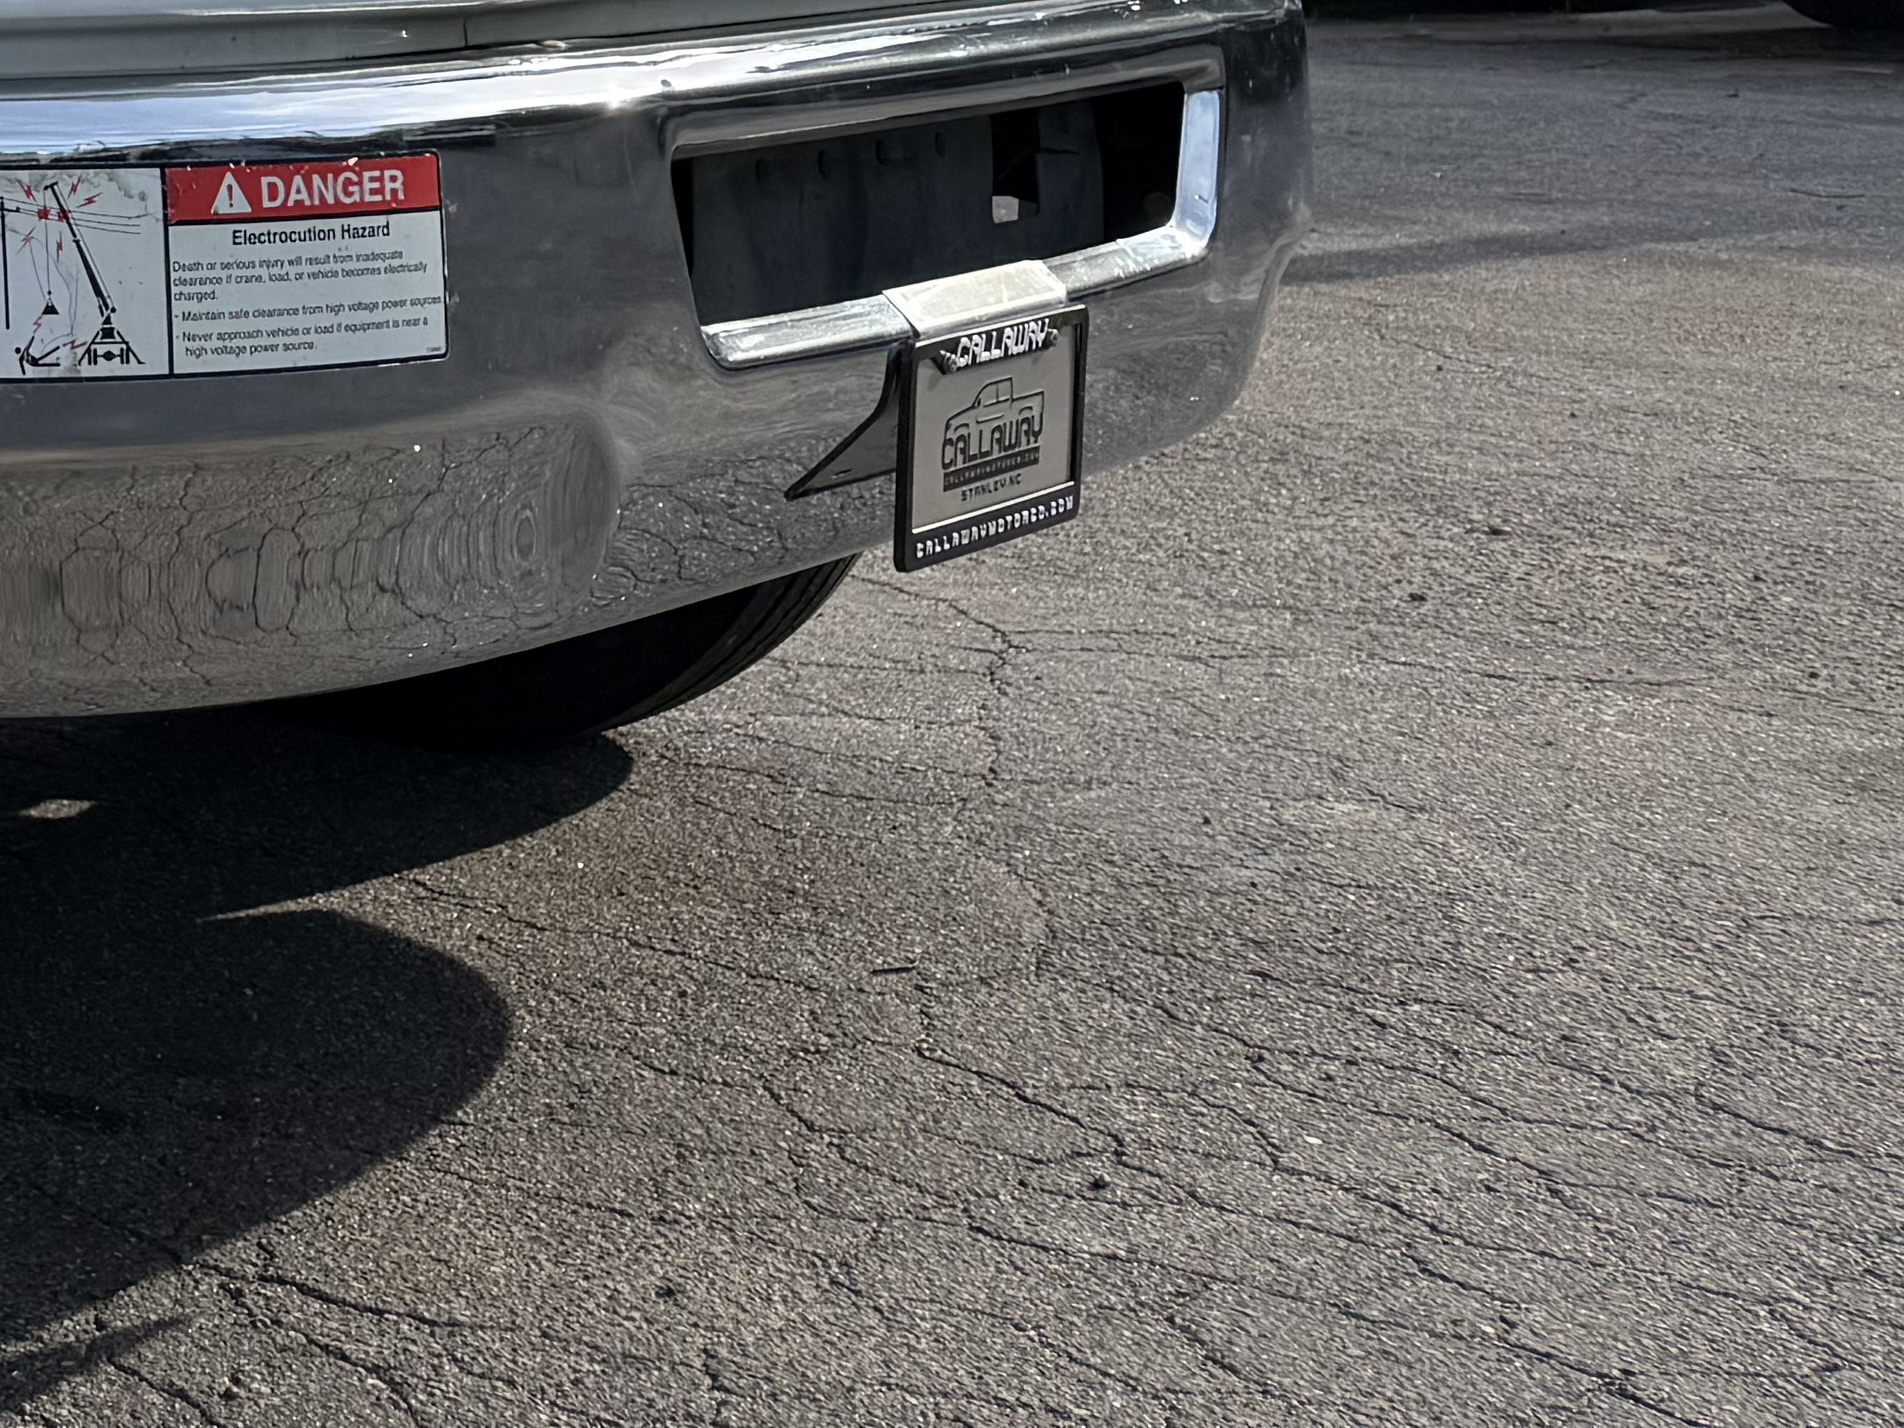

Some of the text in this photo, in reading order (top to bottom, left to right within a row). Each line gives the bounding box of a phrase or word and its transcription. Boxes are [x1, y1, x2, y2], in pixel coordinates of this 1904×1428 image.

[260, 169, 405, 209] DANGER
[232, 220, 390, 246] Electrocution Hazard
[173, 260, 204, 273] Death
[220, 258, 256, 270] serious
[258, 257, 284, 271] injury
[287, 255, 303, 267] will
[305, 254, 331, 266] result
[355, 250, 403, 263] inadequate
[173, 275, 223, 287] clearance
[307, 268, 339, 280] vehicle
[341, 266, 382, 278] becomes
[383, 261, 427, 274] electrically
[173, 290, 218, 303] charged.
[182, 309, 226, 322] Maintain
[228, 308, 250, 320] safe
[252, 306, 300, 319] clearance
[302, 304, 323, 315] from
[325, 303, 345, 316] high
[348, 301, 380, 313] voltage
[182, 331, 213, 343] Never
[216, 329, 264, 343] approach
[265, 326, 300, 338] vehicle
[314, 323, 335, 335] load
[344, 320, 391, 334] equipment
[956, 319, 1050, 368] CALLAWAY
[185, 346, 208, 360] high
[210, 345, 247, 358] voltage
[249, 343, 280, 356] power
[942, 412, 1043, 471] CALLAWAY
[916, 495, 1074, 559] CALLAWAYMOTORCO.COM
